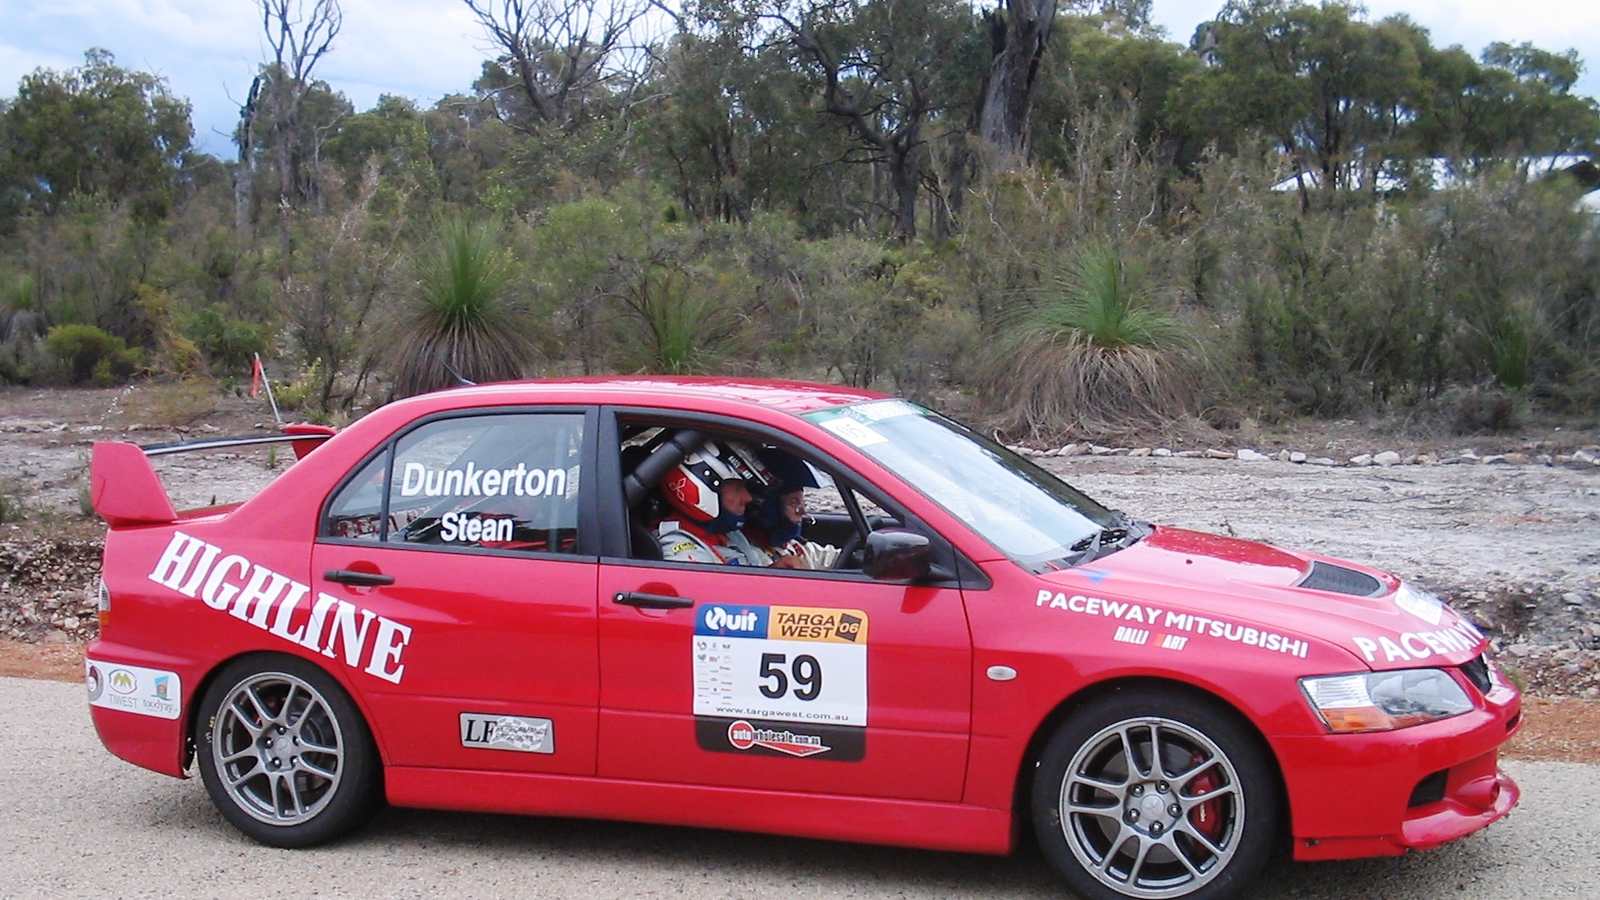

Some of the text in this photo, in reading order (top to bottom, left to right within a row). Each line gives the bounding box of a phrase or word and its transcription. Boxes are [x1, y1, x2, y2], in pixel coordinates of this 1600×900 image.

[401, 461, 567, 497] Dunkerton
[440, 511, 515, 541] Stean
[148, 531, 412, 685] HIGHLINE
[705, 606, 758, 633] Quit
[776, 612, 836, 627] TARGA
[781, 625, 834, 639] WEST
[839, 623, 859, 635] 06
[1035, 589, 1309, 658] PACEWAY MITSUBISHI
[1113, 626, 1149, 645] RALLI
[1352, 619, 1485, 663] PACEWAY
[758, 652, 823, 702] 59
[716, 706, 849, 721] www.targawest.com.au
